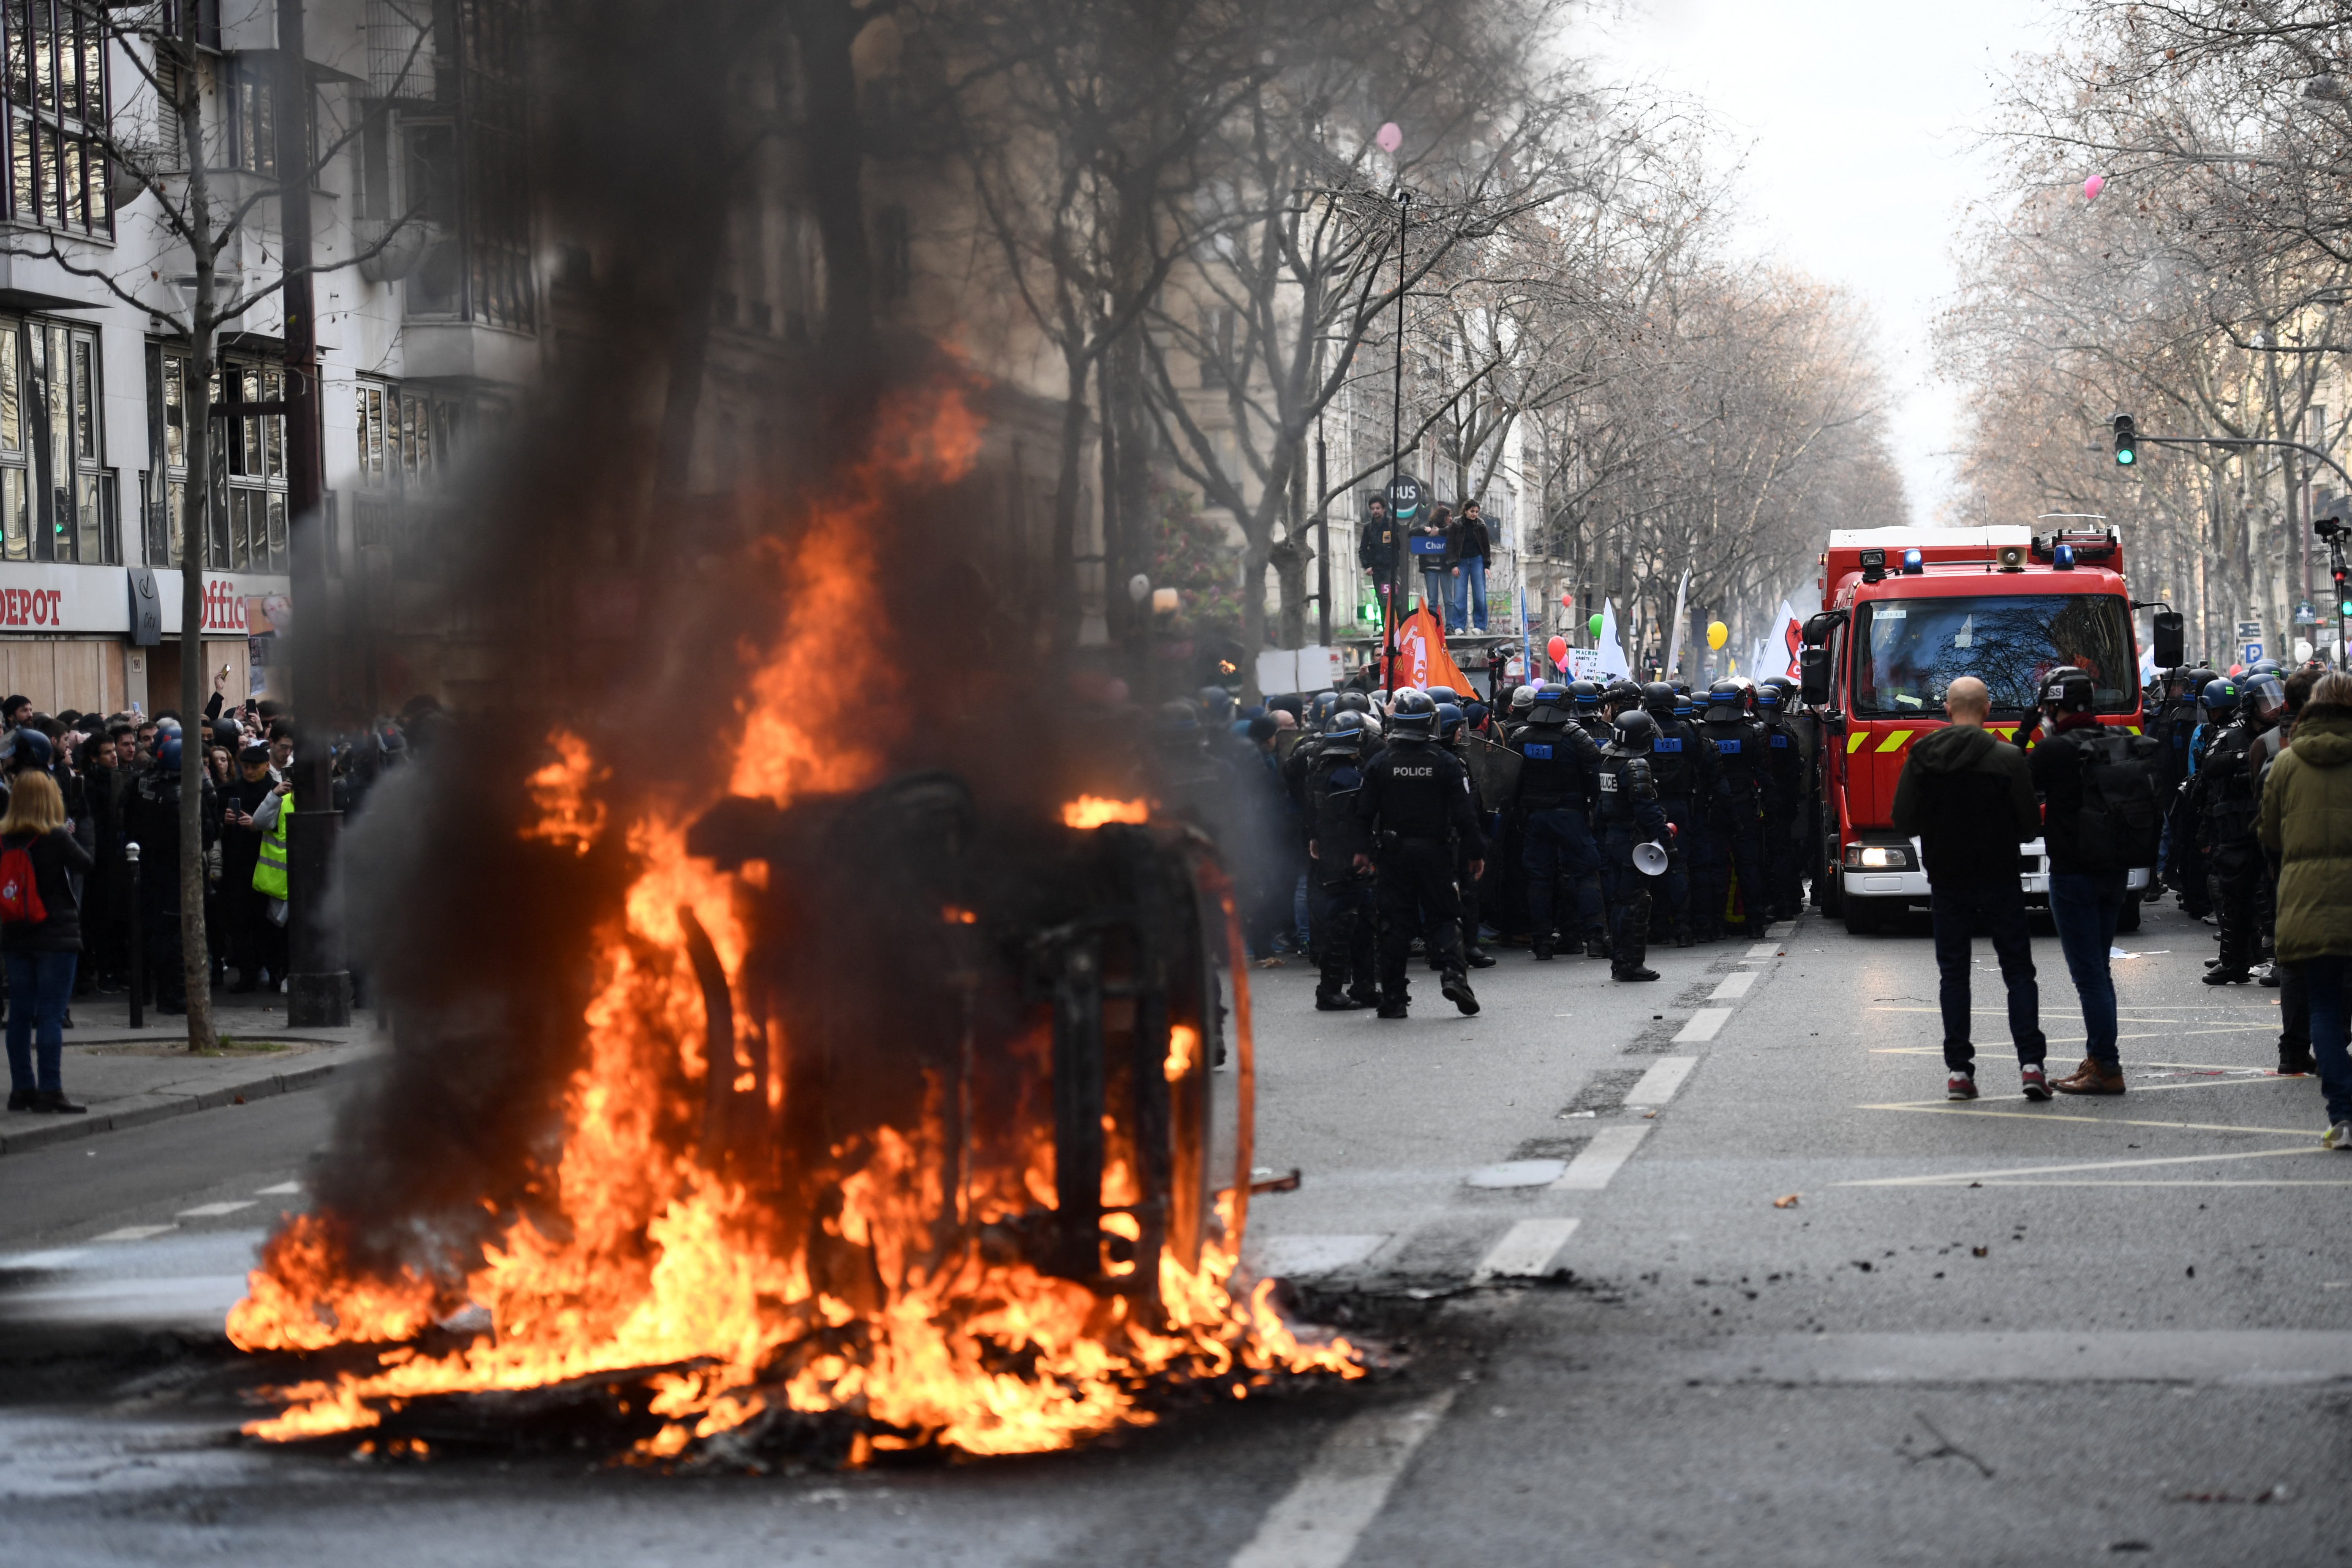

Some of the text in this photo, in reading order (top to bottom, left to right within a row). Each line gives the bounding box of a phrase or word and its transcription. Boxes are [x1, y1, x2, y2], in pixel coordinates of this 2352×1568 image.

[1391, 485, 1416, 499] BUS
[1425, 541, 1446, 549] Char
[1383, 584, 1389, 593] 5
[201, 580, 248, 629] ffic
[144, 612, 156, 634] City
[2250, 646, 2260, 661] P
[2050, 688, 2061, 697] SS
[1614, 727, 1626, 743] TI
[1394, 767, 1432, 776] POLICE
[1601, 776, 1617, 789] OLICE
